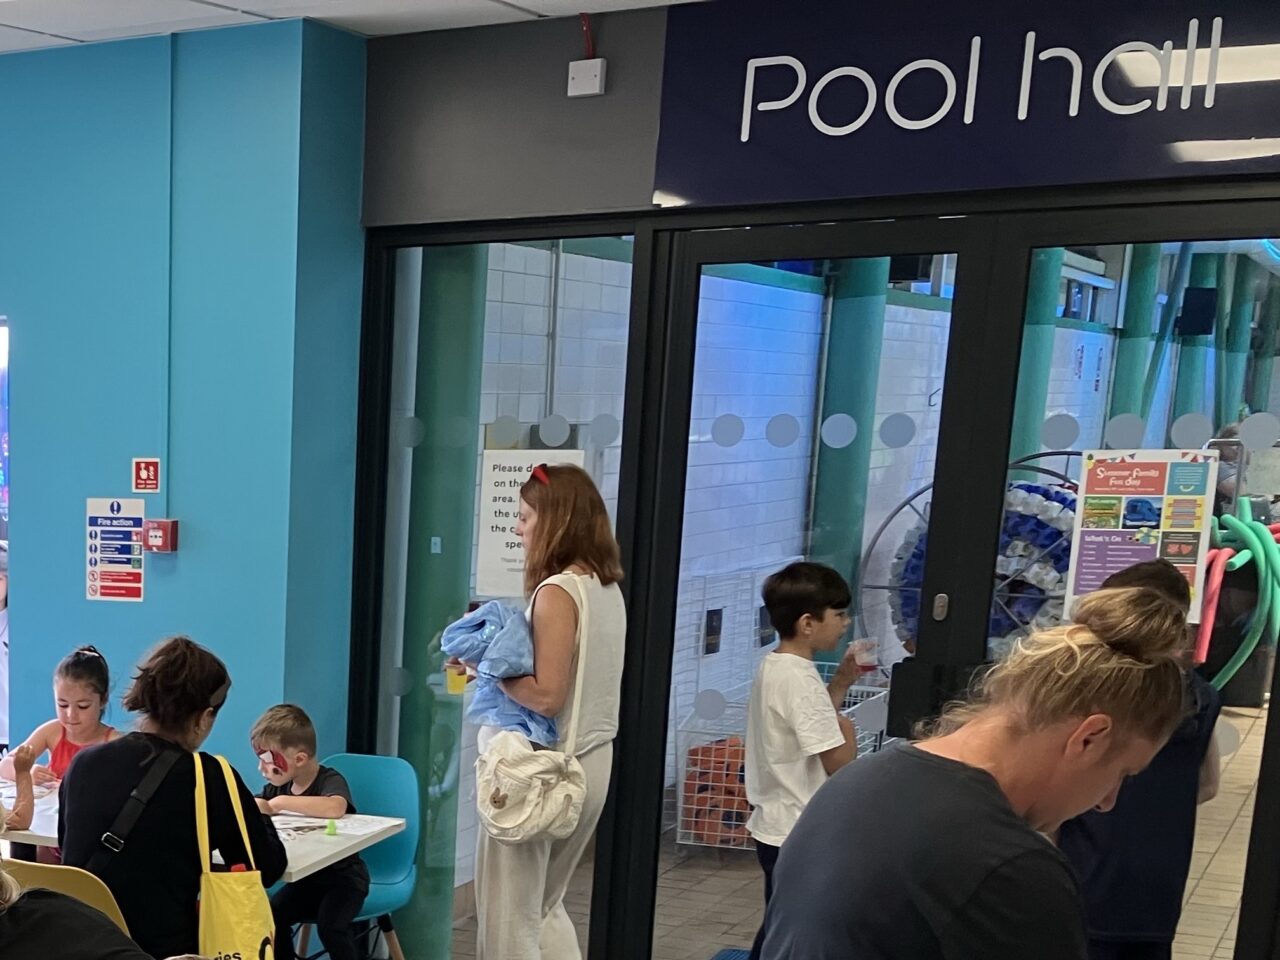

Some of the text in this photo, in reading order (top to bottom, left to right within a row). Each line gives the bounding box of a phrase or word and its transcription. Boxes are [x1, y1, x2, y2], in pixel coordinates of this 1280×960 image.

[740, 17, 1223, 142] Pool hall
[492, 464, 523, 473] Please
[494, 509, 510, 518] the
[98, 518, 134, 527] Fire action
[491, 525, 507, 533] the
